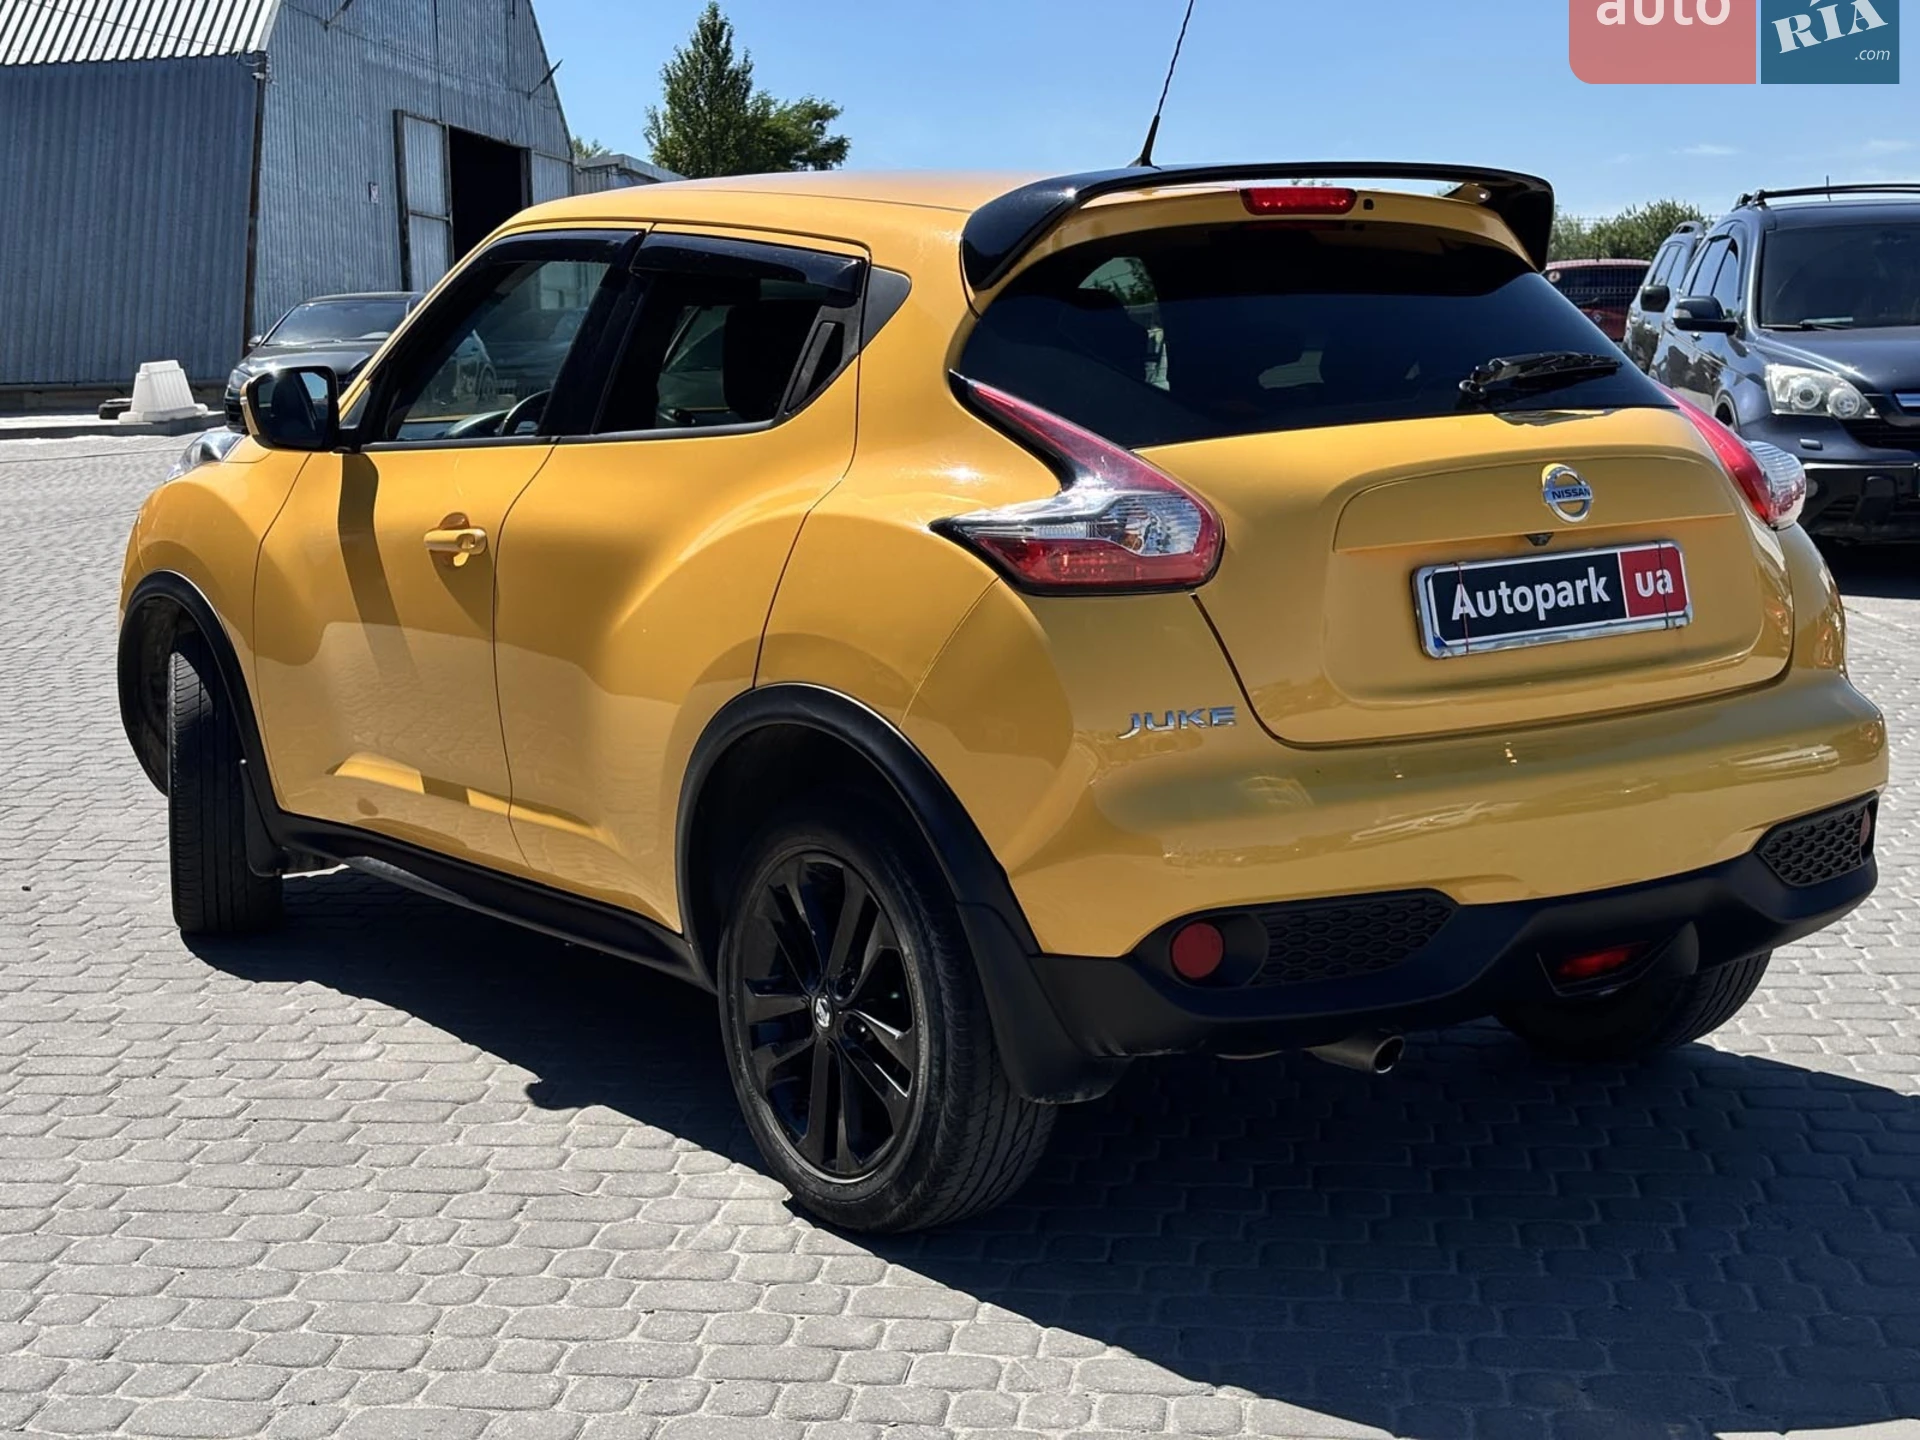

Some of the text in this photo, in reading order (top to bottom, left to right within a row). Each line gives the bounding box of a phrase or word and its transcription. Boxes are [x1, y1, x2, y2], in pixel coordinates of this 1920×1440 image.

[1551, 486, 1591, 500] NISSAN
[1451, 566, 1674, 621] Autopark ua
[1116, 706, 1237, 739] JUKE
